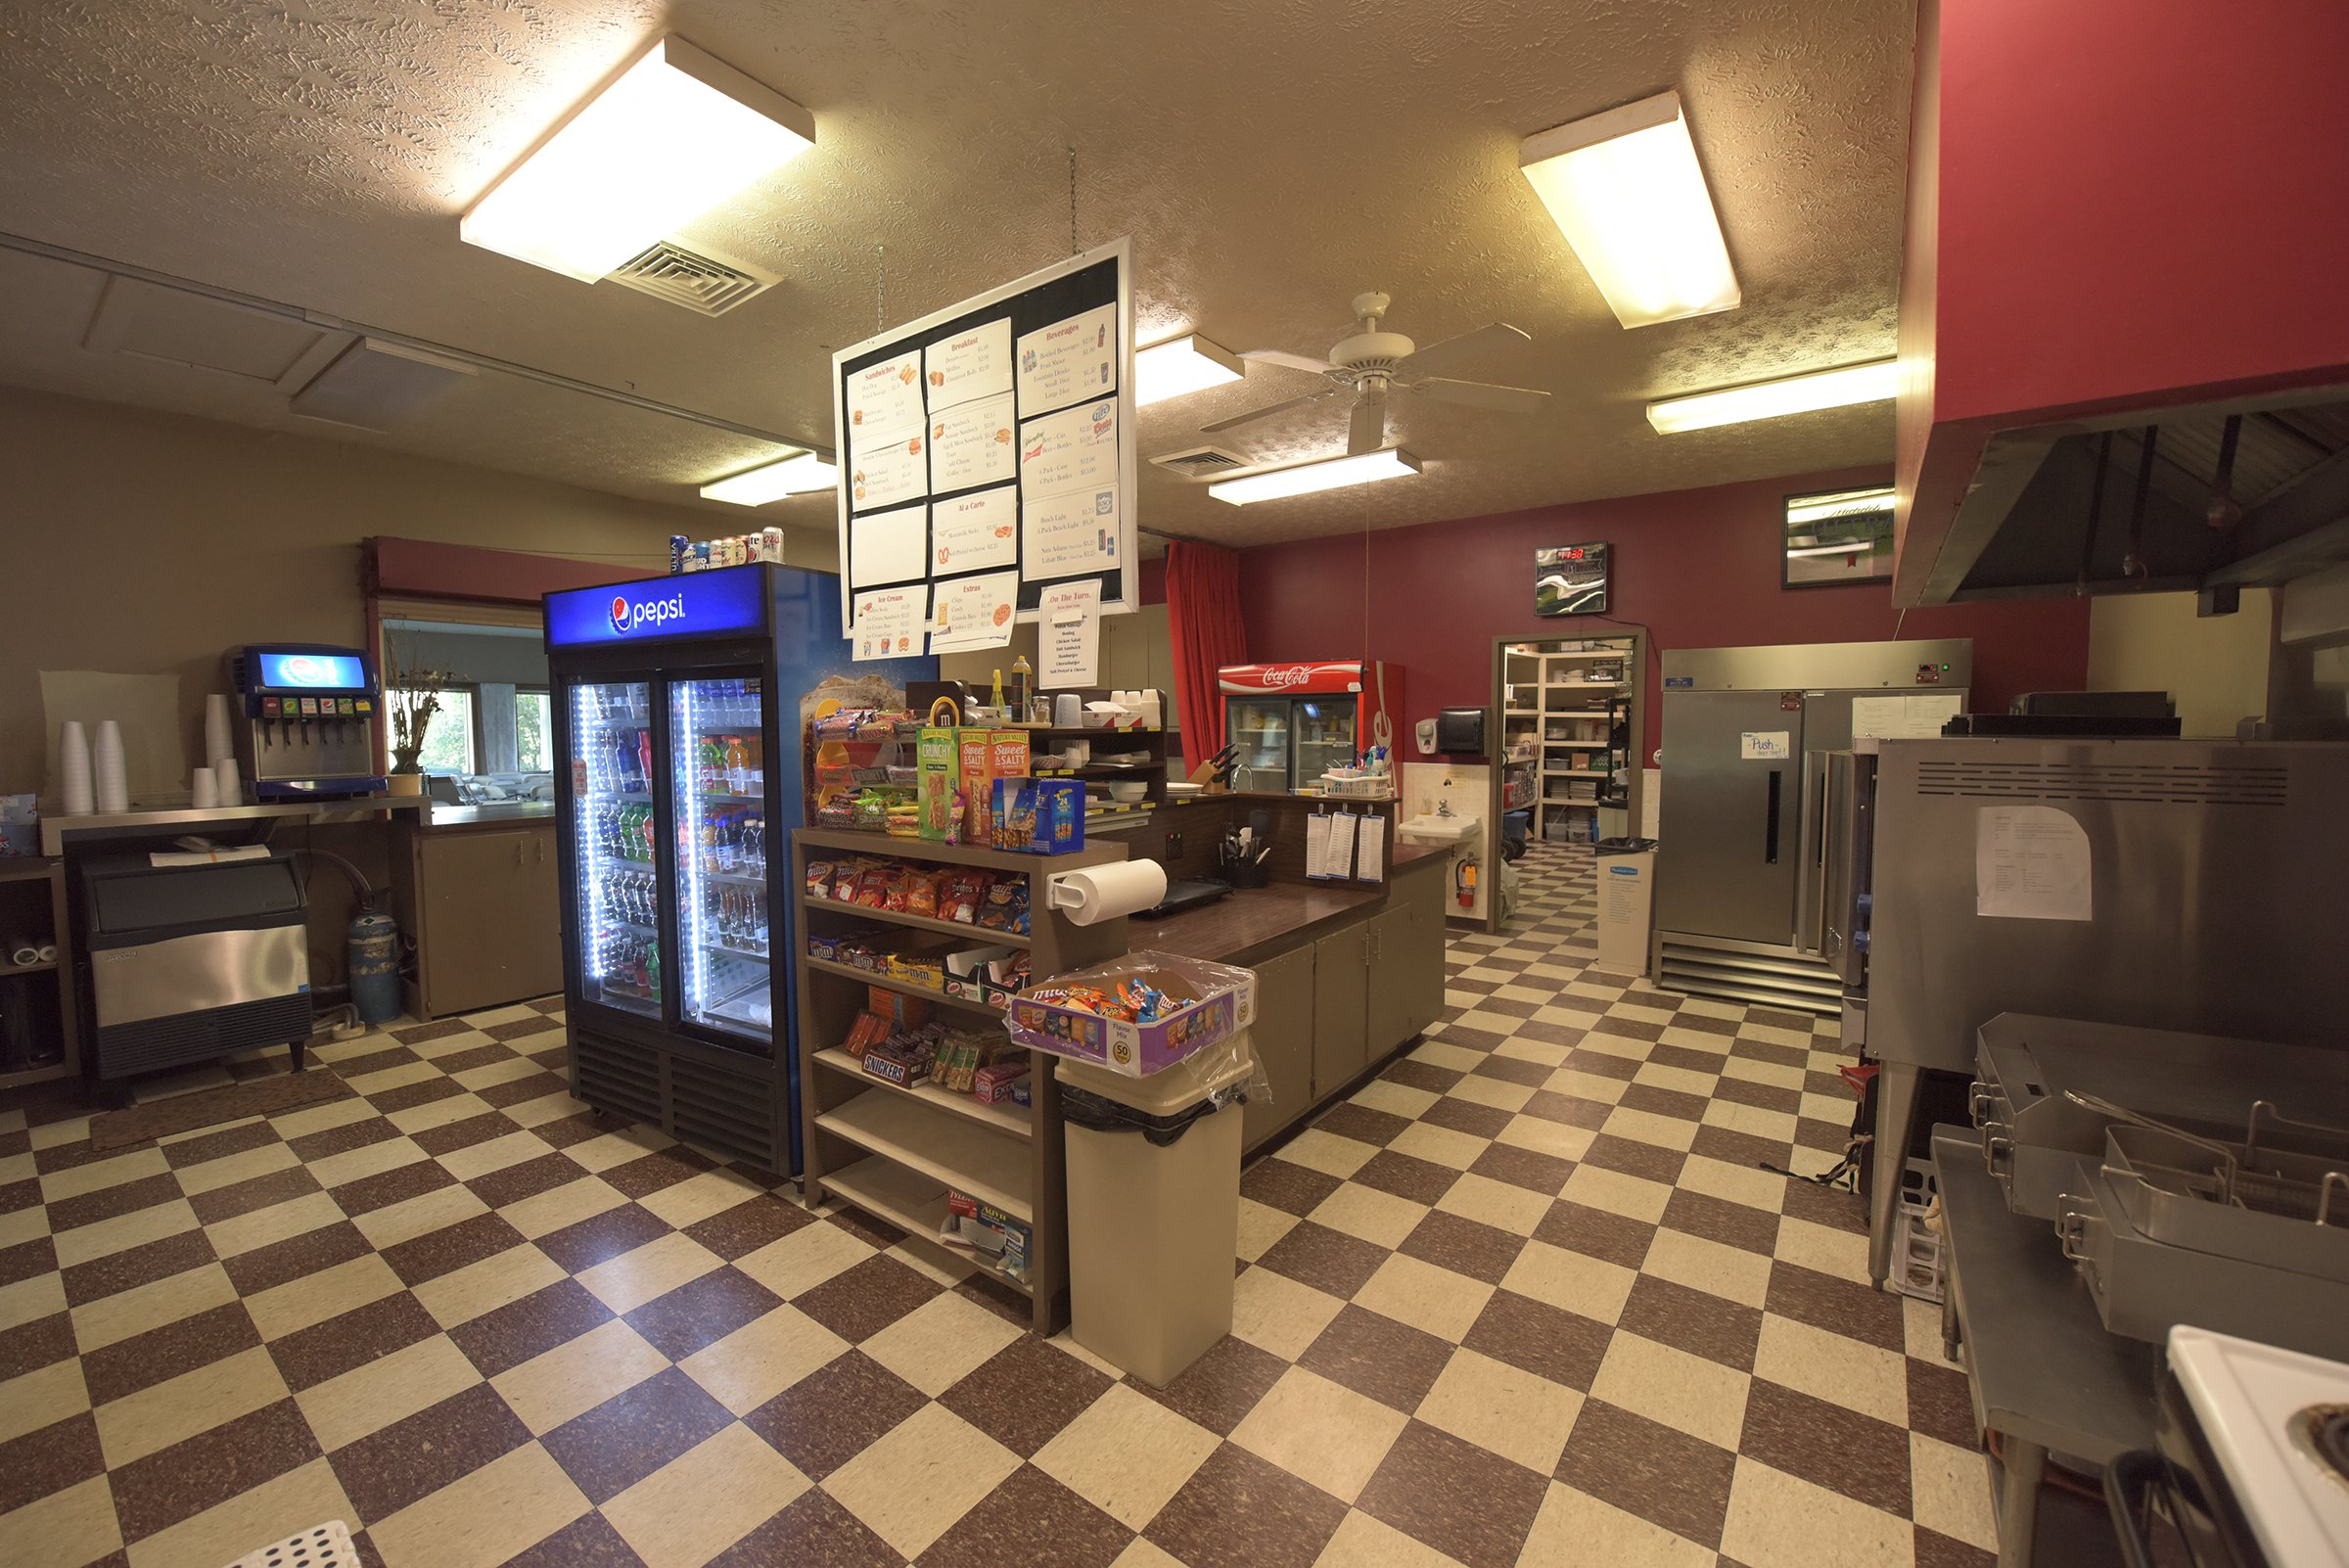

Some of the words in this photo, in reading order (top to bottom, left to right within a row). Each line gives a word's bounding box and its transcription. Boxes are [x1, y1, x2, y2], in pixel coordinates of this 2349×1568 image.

[1046, 324, 1080, 341] Beverages
[951, 336, 978, 352] Breakfast
[864, 366, 896, 381] Sandwiches
[969, 500, 986, 509] Carte
[963, 585, 981, 594] Extras
[886, 595, 904, 603] Cream
[1050, 595, 1059, 603] On
[1060, 593, 1072, 602] The
[634, 593, 683, 629] pepsi
[1263, 666, 1313, 686] Coca-Cola
[992, 735, 1009, 743] NATURE
[1751, 738, 1773, 750] Push
[922, 745, 951, 758] CRUNCHY
[964, 745, 986, 755] Sweet
[995, 745, 1027, 755] Sweet
[968, 756, 985, 764] SALTY
[995, 756, 1001, 766] &
[1001, 755, 1025, 765] SALTY
[1112, 1023, 1131, 1033] Flavor
[1116, 1031, 1127, 1039] Mix
[1117, 1045, 1128, 1057] 50
[865, 1057, 904, 1082] SNICKERS
